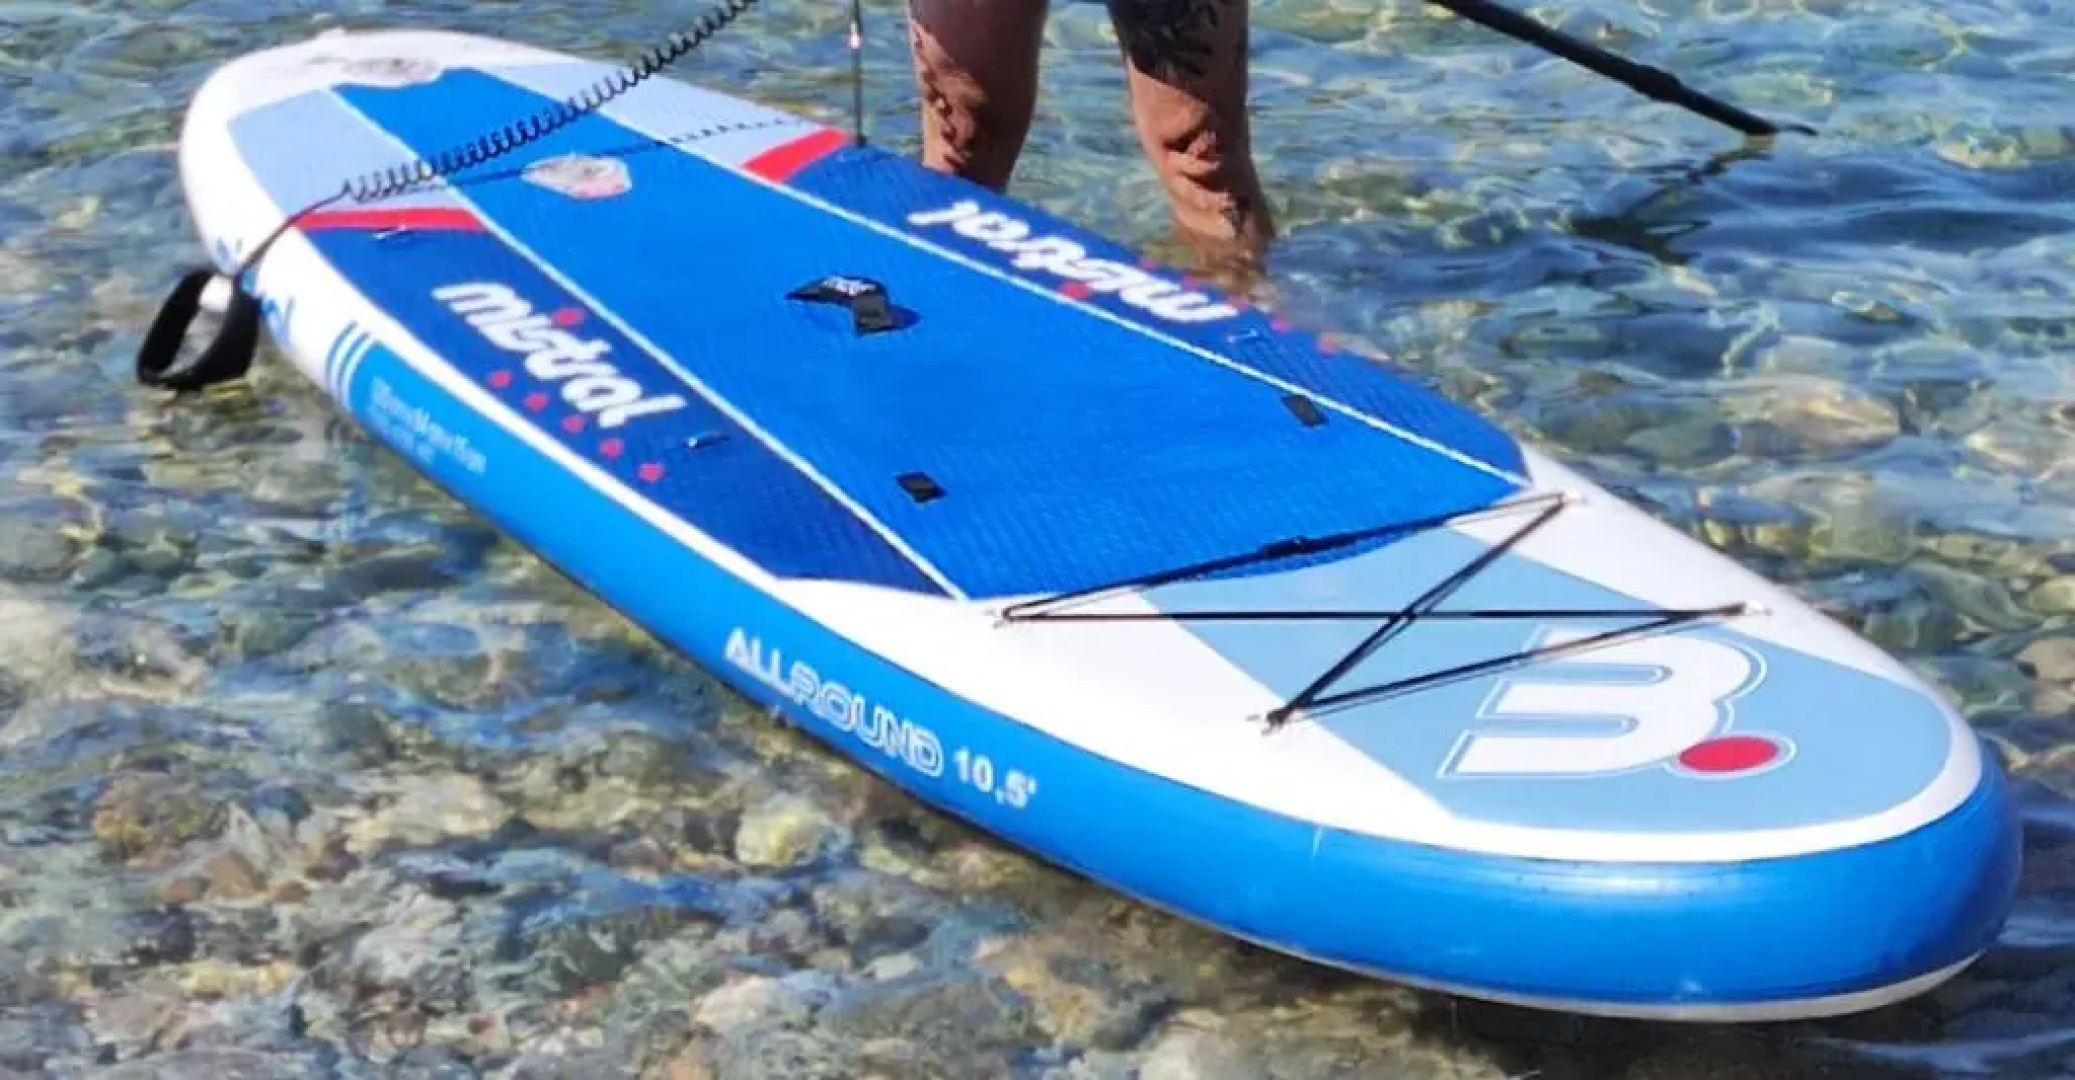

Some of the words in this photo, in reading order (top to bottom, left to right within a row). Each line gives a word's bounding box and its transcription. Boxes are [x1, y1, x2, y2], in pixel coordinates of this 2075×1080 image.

[906, 199, 1239, 324] mistral
[430, 280, 690, 428] mistral
[724, 626, 945, 779] ALLROUND
